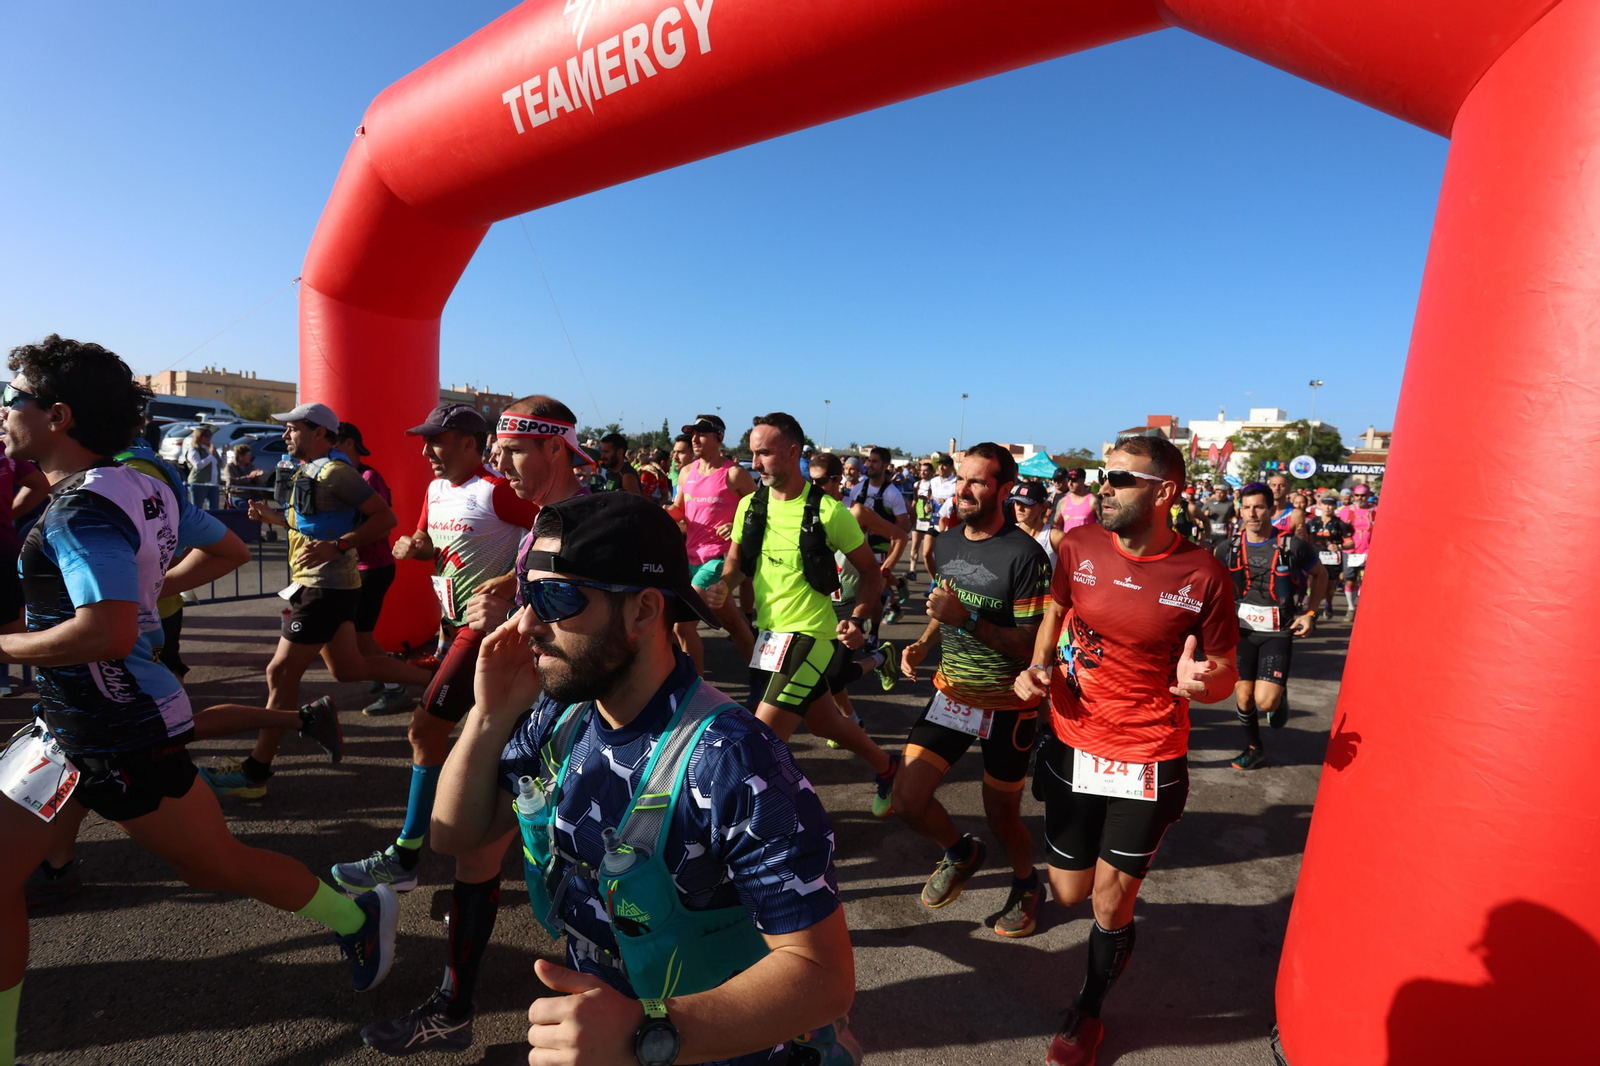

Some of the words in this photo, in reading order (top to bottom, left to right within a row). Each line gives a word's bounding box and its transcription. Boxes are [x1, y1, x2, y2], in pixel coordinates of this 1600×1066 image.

[502, 0, 714, 135] TEAMERGY
[1322, 464, 1350, 473] TRAIL
[642, 563, 665, 573] FILA
[1113, 579, 1142, 591] TEAMERGY
[957, 589, 1003, 610] TRAINING
[1160, 591, 1203, 608] LIBERTIUM
[1246, 614, 1265, 623] 429
[759, 643, 777, 656] 404
[944, 698, 972, 717] 353
[1092, 756, 1129, 776] 124
